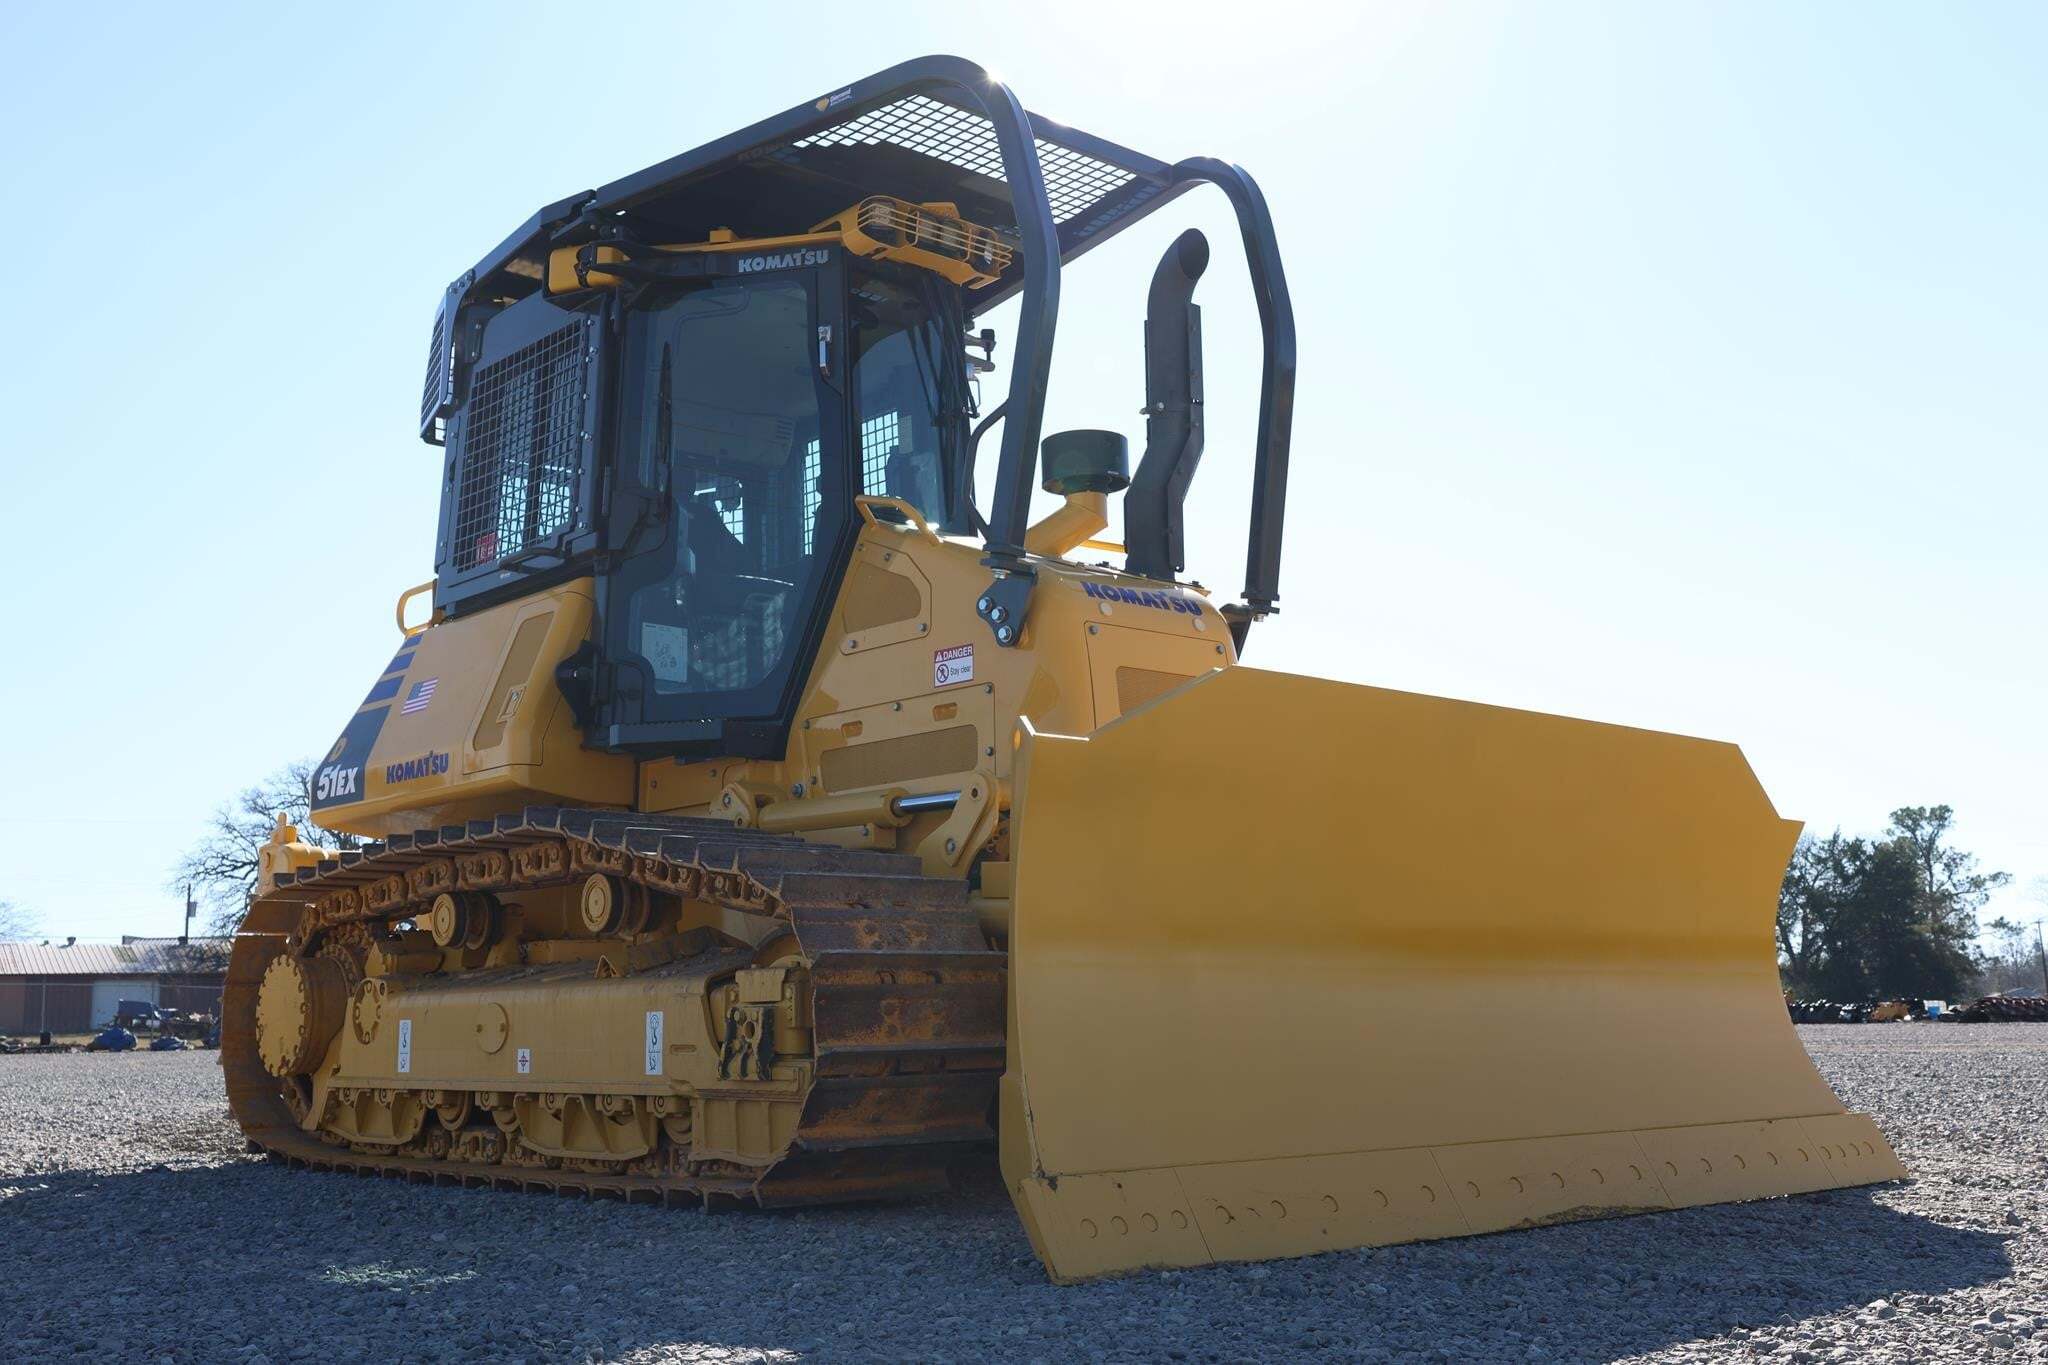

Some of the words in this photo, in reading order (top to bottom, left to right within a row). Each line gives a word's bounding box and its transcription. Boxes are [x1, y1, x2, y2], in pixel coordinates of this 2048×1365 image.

[738, 248, 829, 273] KOMATSU
[1080, 581, 1203, 616] KOMATSU
[943, 645, 973, 661] DANGER
[316, 764, 359, 800] 51EX
[386, 750, 450, 785] KOMATSU
